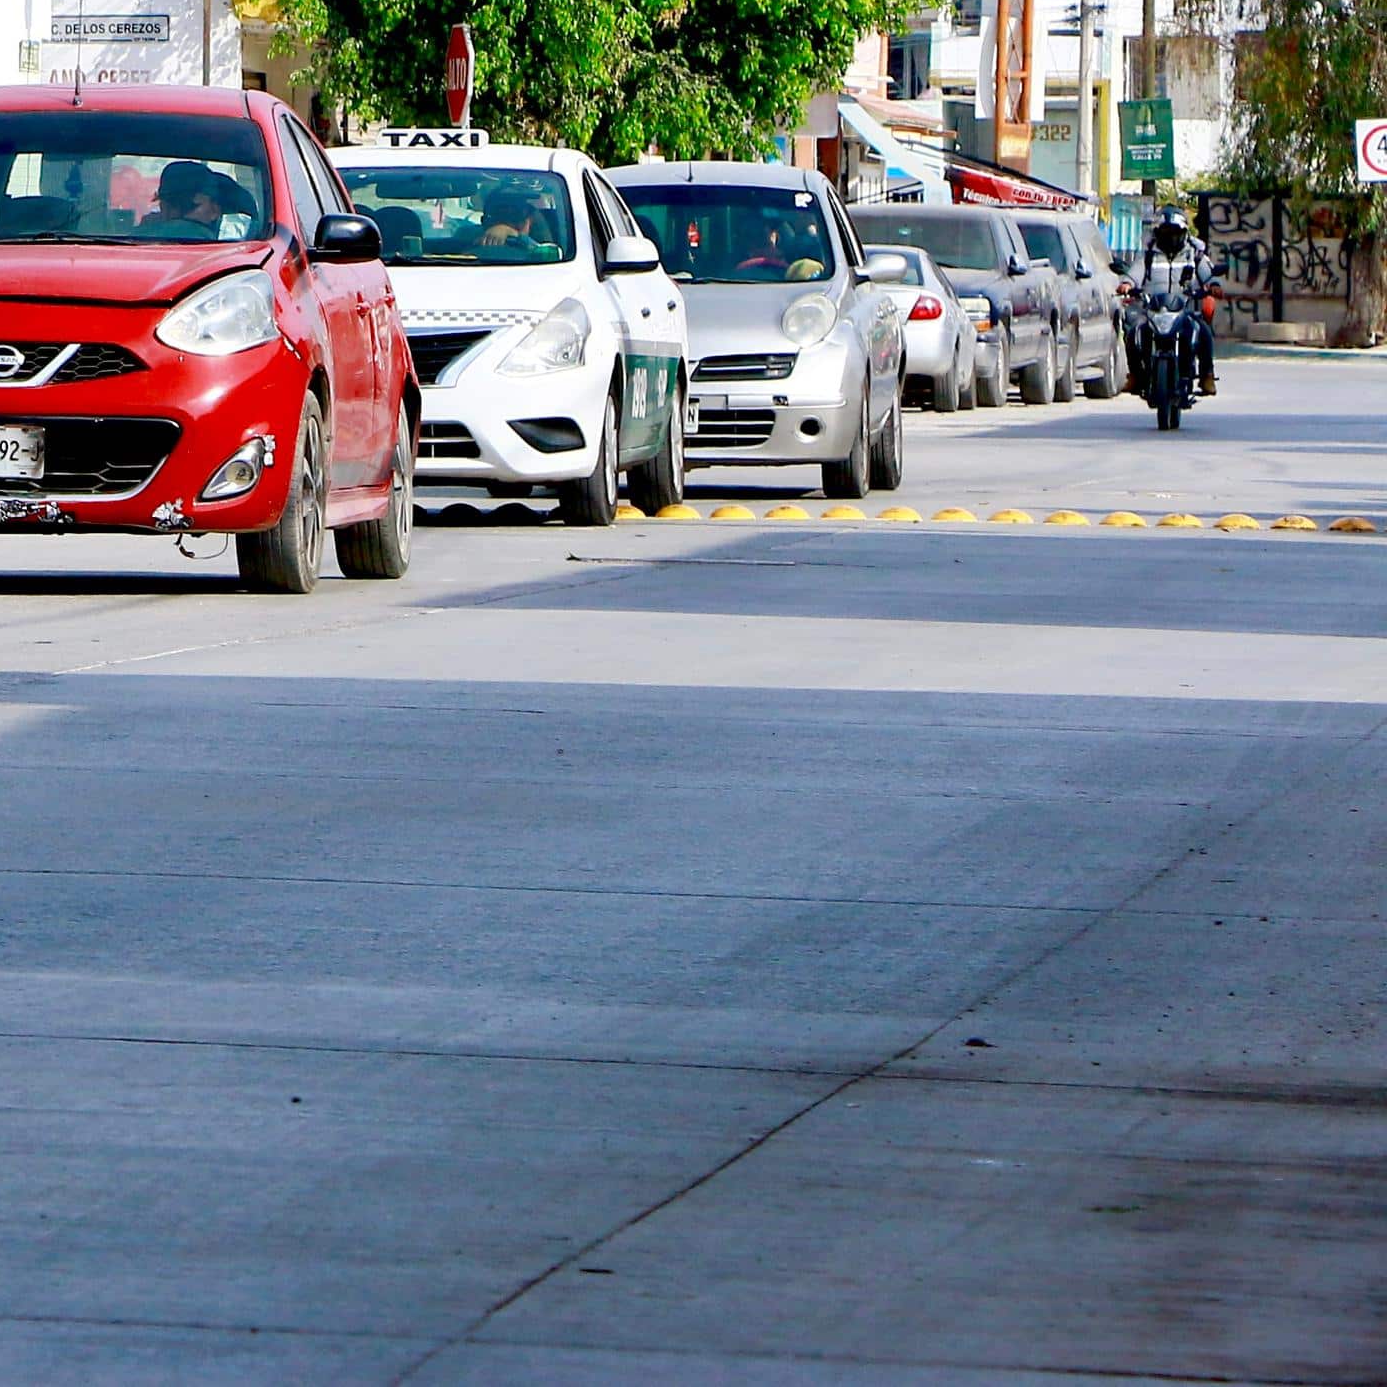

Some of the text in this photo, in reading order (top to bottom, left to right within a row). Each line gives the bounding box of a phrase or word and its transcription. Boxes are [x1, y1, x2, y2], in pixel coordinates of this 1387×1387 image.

[65, 24, 81, 34] DE
[83, 24, 105, 34] LOS
[108, 23, 161, 34] CEREZOS
[382, 133, 480, 147] TAXI
